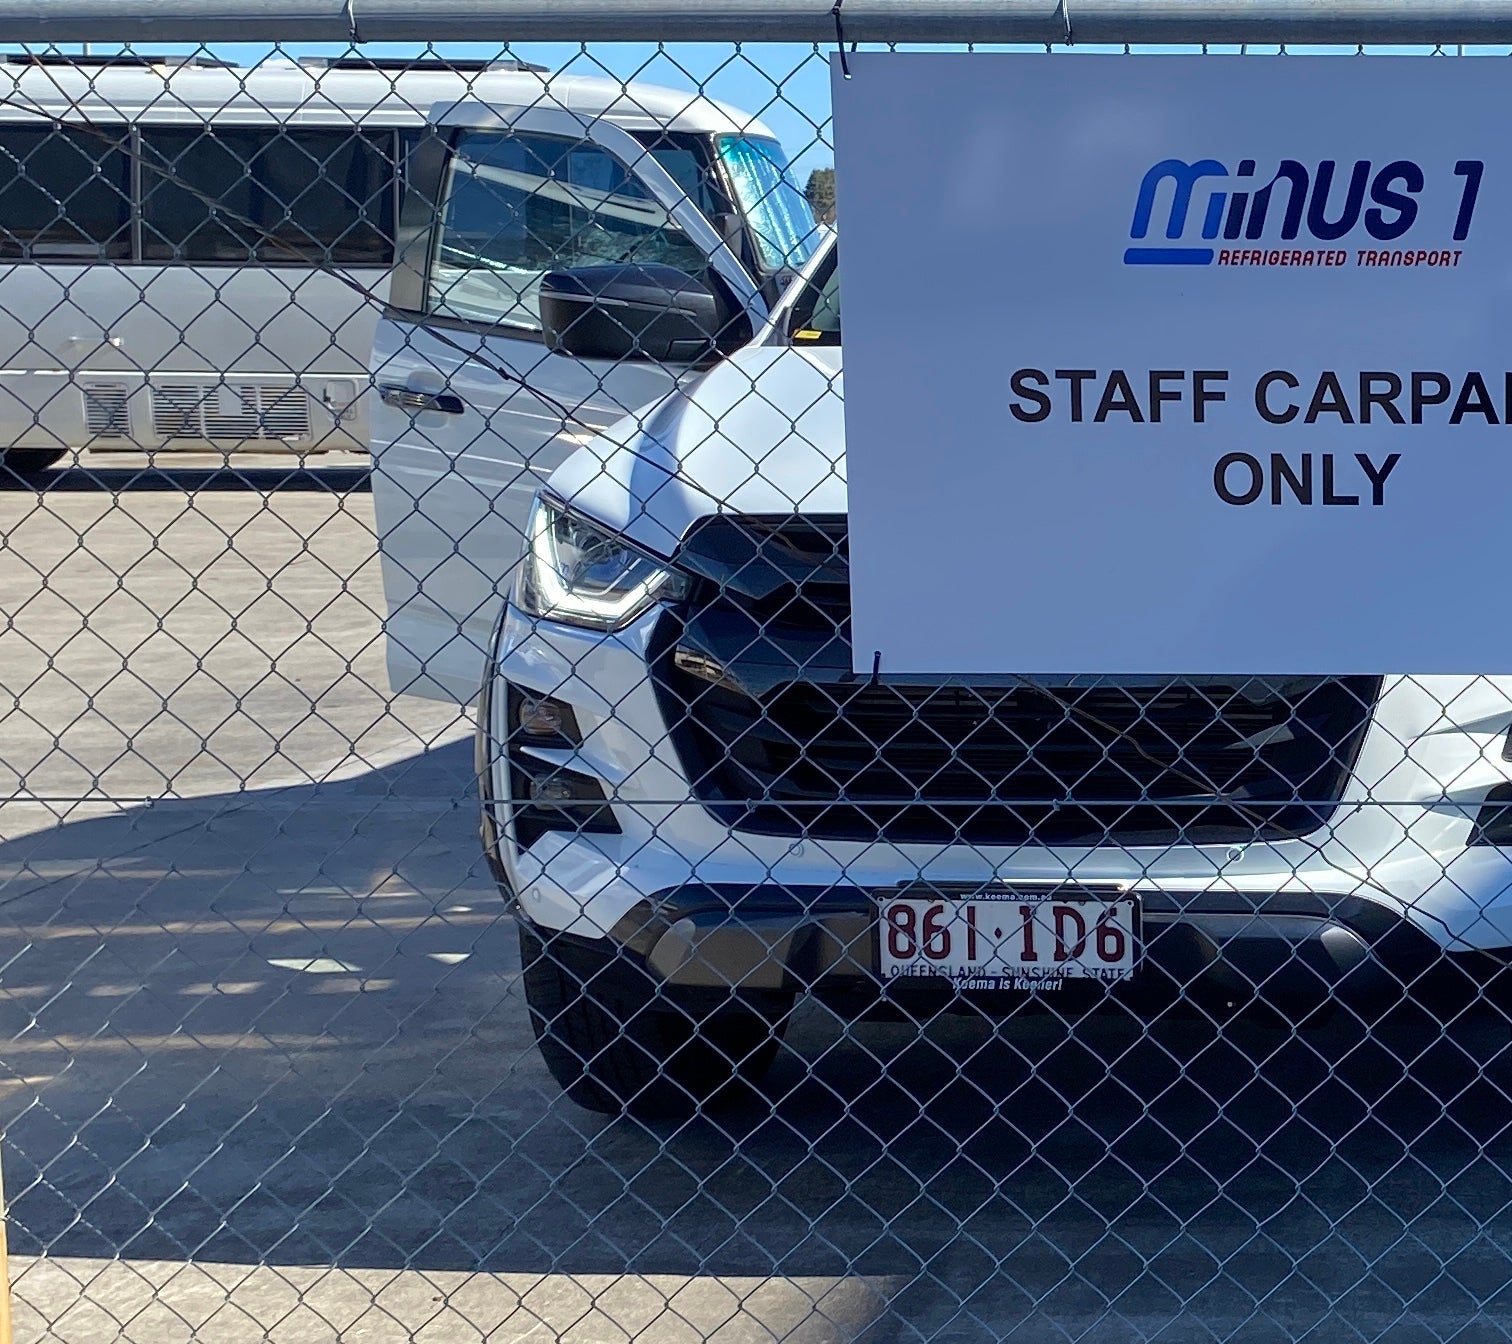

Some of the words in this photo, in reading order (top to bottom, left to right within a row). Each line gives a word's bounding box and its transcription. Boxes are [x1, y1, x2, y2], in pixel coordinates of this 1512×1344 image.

[1452, 160, 1484, 241] 1
[1217, 249, 1347, 267] REFRIGERATED
[1009, 369, 1229, 423] STAFF
[1214, 452, 1402, 506] ONLY
